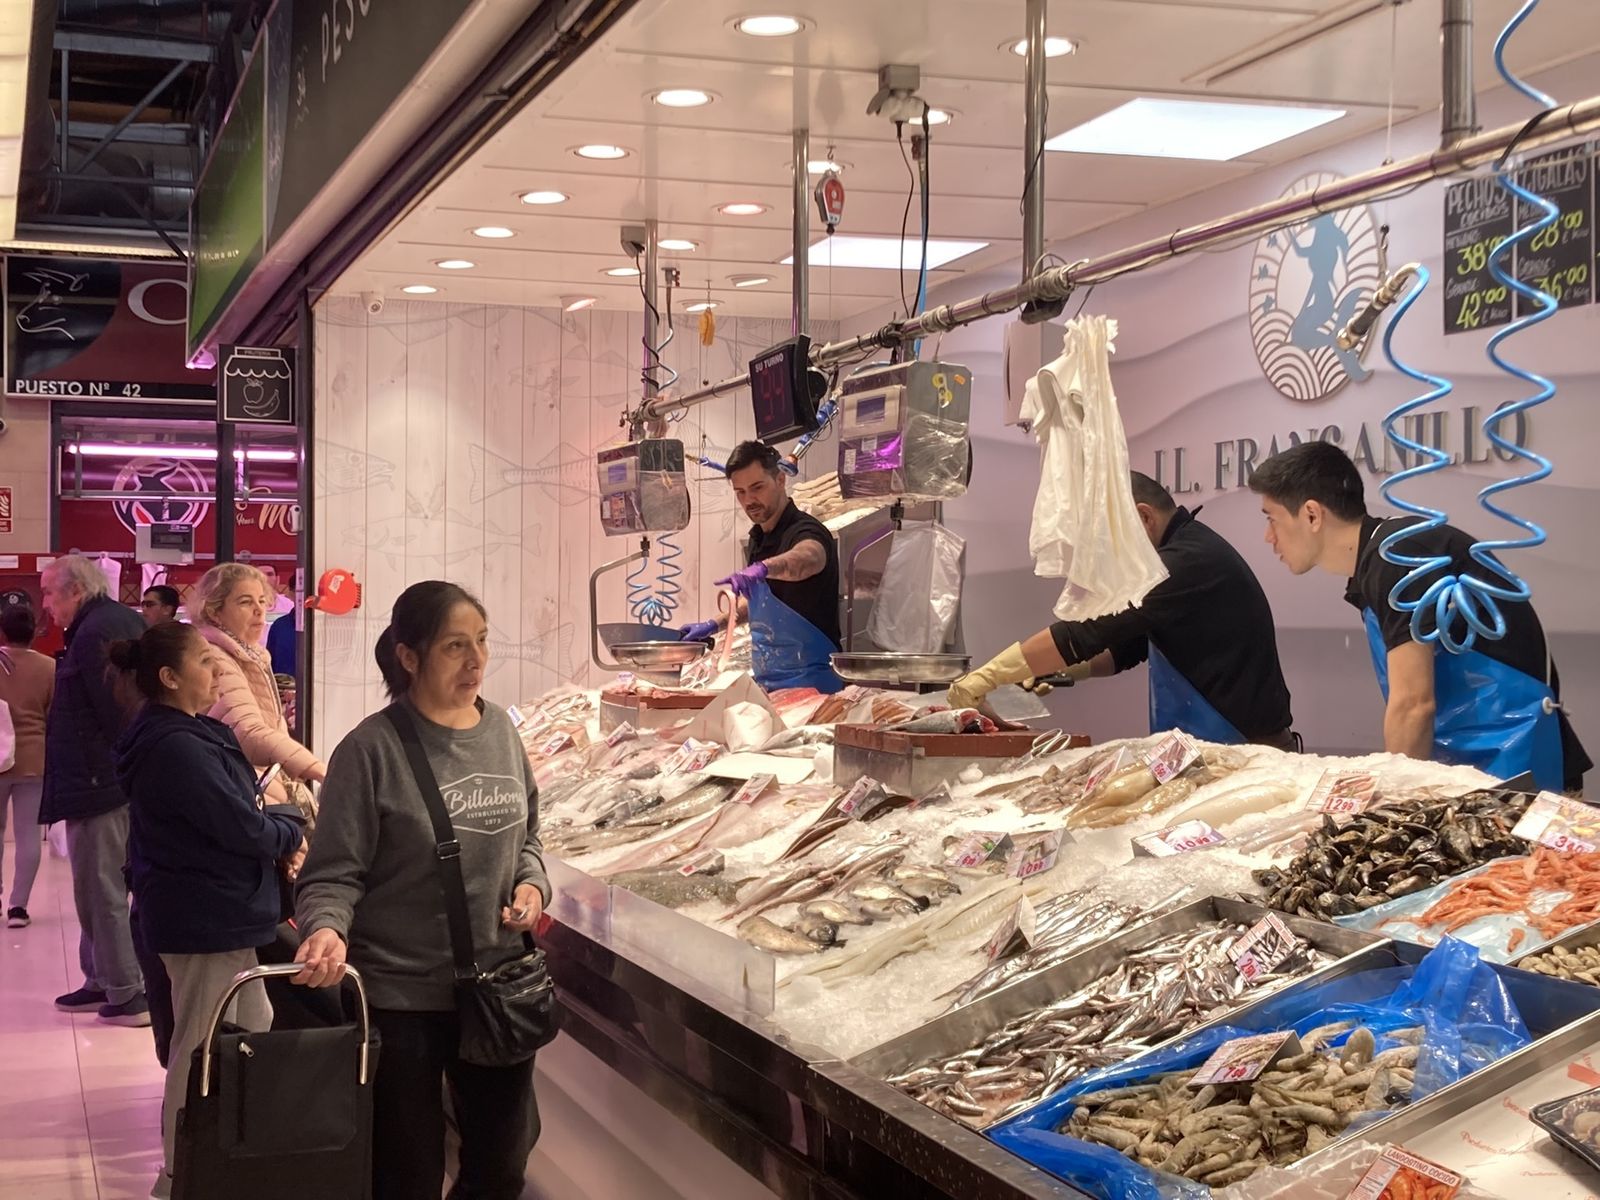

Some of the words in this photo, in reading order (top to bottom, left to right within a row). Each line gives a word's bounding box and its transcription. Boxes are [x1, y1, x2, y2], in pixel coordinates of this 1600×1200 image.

[321, 0, 371, 84] PES
[754, 361, 764, 374] SU
[764, 352, 784, 370] TURNO
[15, 379, 83, 396] PUESTO
[121, 383, 141, 398] 42
[1214, 399, 1530, 490] FRAANILLO
[1429, 1167, 1457, 1186] COCIDO
